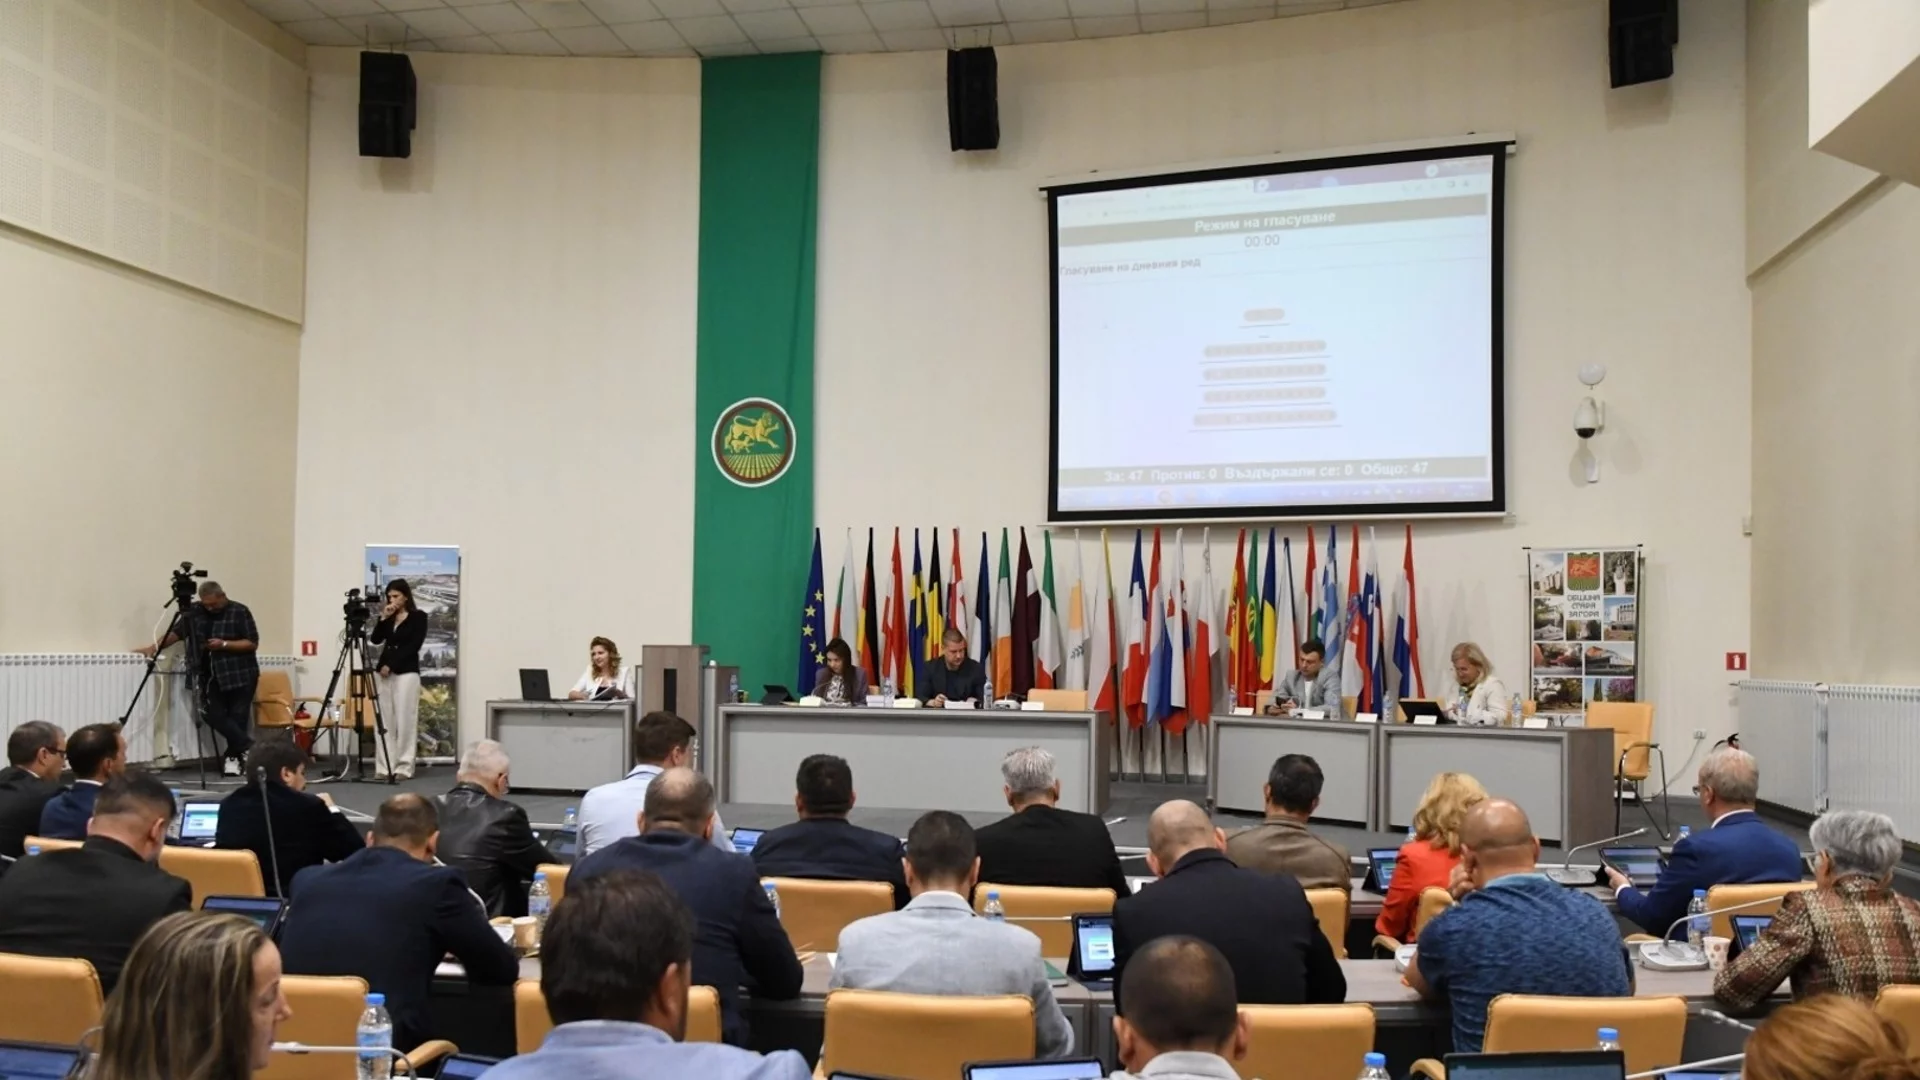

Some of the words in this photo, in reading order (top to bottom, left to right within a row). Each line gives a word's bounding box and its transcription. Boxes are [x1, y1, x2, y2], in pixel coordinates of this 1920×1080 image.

[1194, 219, 1240, 232] Режим
[1243, 217, 1260, 229] на
[1263, 211, 1337, 227] гласуване
[1244, 234, 1280, 248] 00:00
[1117, 262, 1129, 272] на
[1181, 258, 1201, 269] ред
[1104, 470, 1124, 482] За:
[1127, 469, 1143, 481] 47
[1151, 467, 1205, 483] Против:
[1209, 468, 1217, 480] 0
[1225, 465, 1316, 482] Въздържали
[1320, 466, 1340, 478] се:
[1345, 464, 1353, 477] 0
[1361, 462, 1408, 477] Общо:
[1412, 461, 1429, 474] 47
